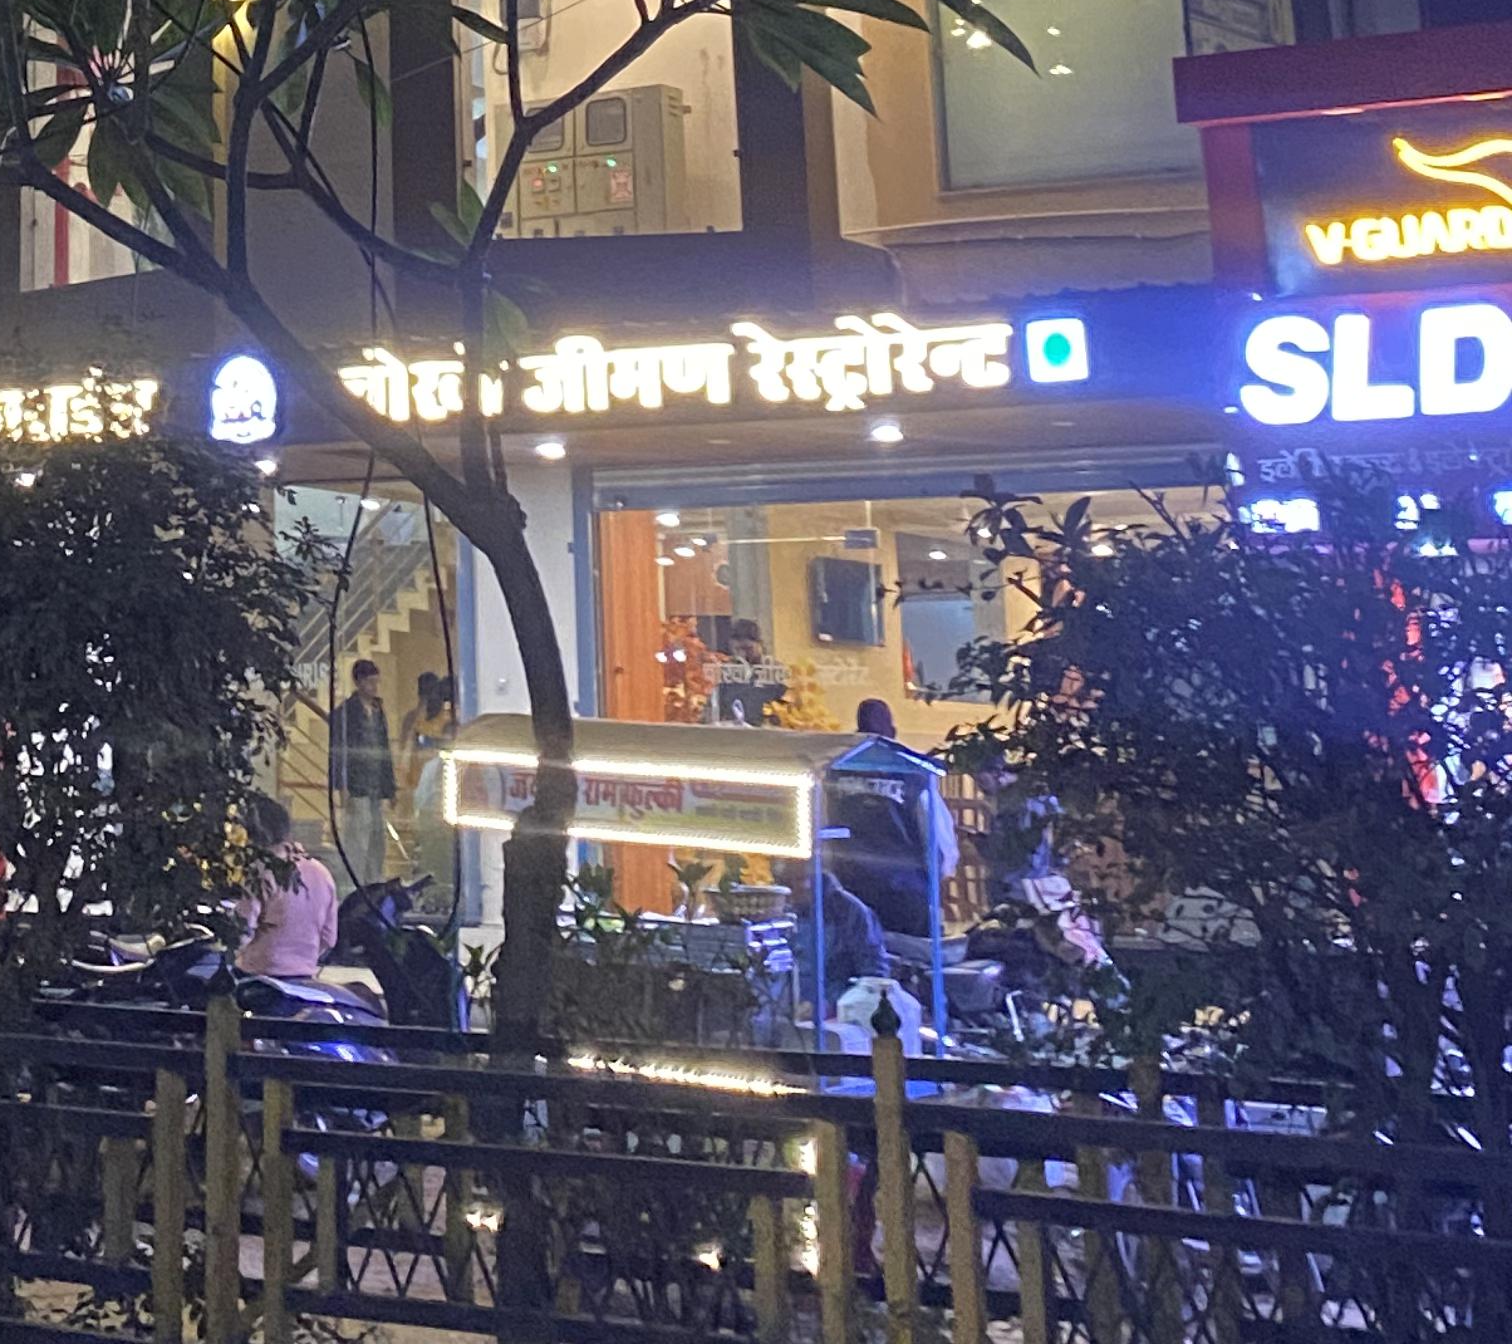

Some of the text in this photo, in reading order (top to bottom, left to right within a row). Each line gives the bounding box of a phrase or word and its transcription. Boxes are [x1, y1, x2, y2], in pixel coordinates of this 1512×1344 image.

[1305, 205, 1512, 265] V-GUARD
[518, 334, 735, 414] जीमण
[1240, 303, 1512, 425] SLD
